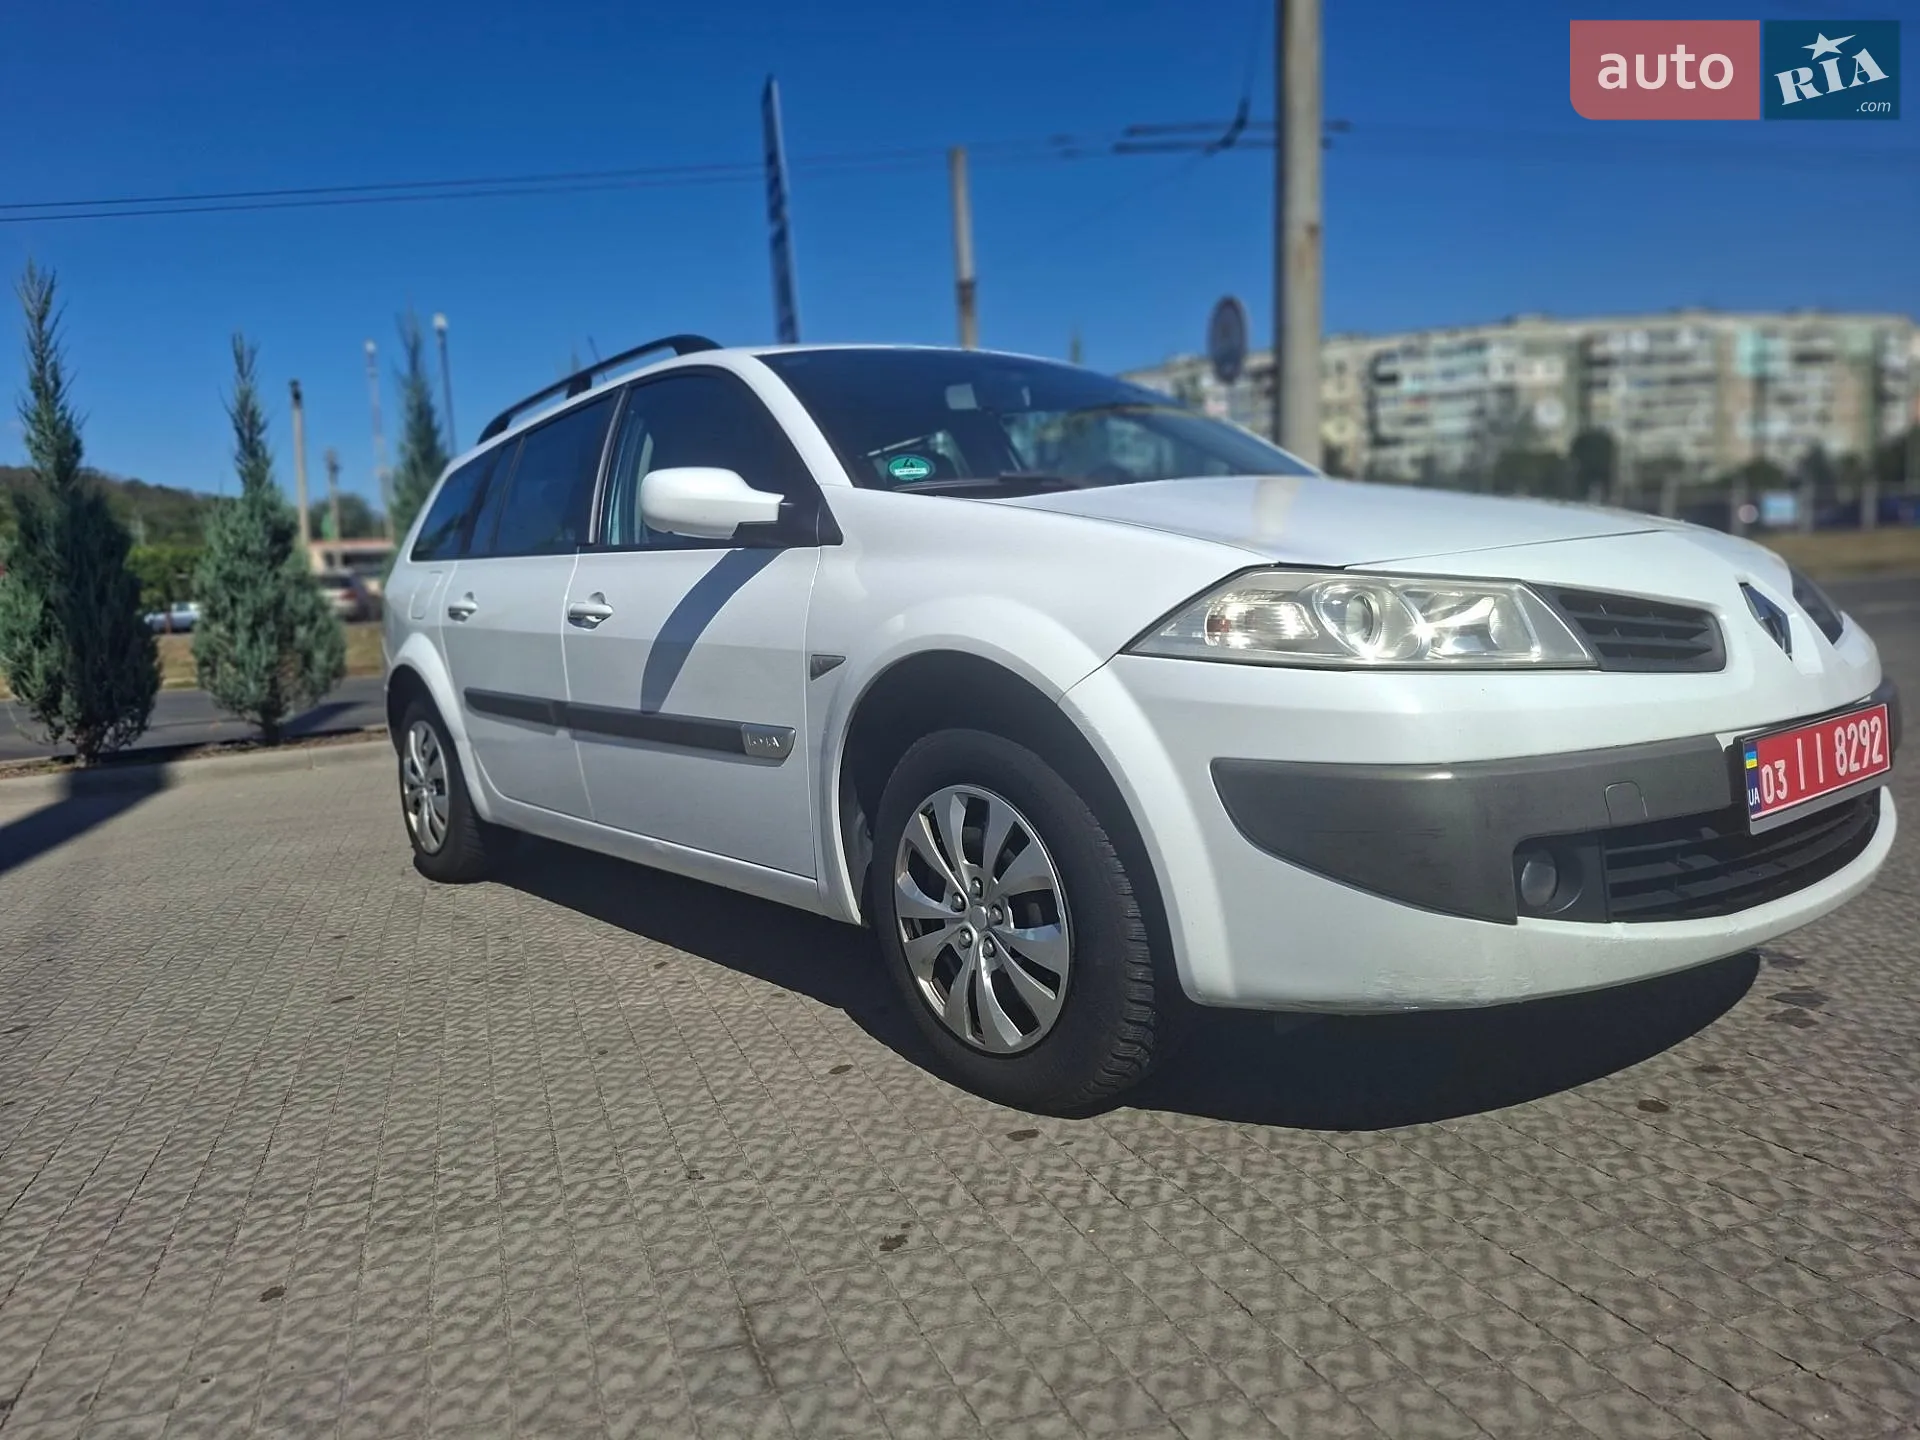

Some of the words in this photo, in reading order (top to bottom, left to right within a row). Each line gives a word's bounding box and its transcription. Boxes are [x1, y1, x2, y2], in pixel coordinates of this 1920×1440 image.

[1761, 759, 1788, 804] 03
[1834, 715, 1883, 776] 8292
[1748, 787, 1760, 806] UA
